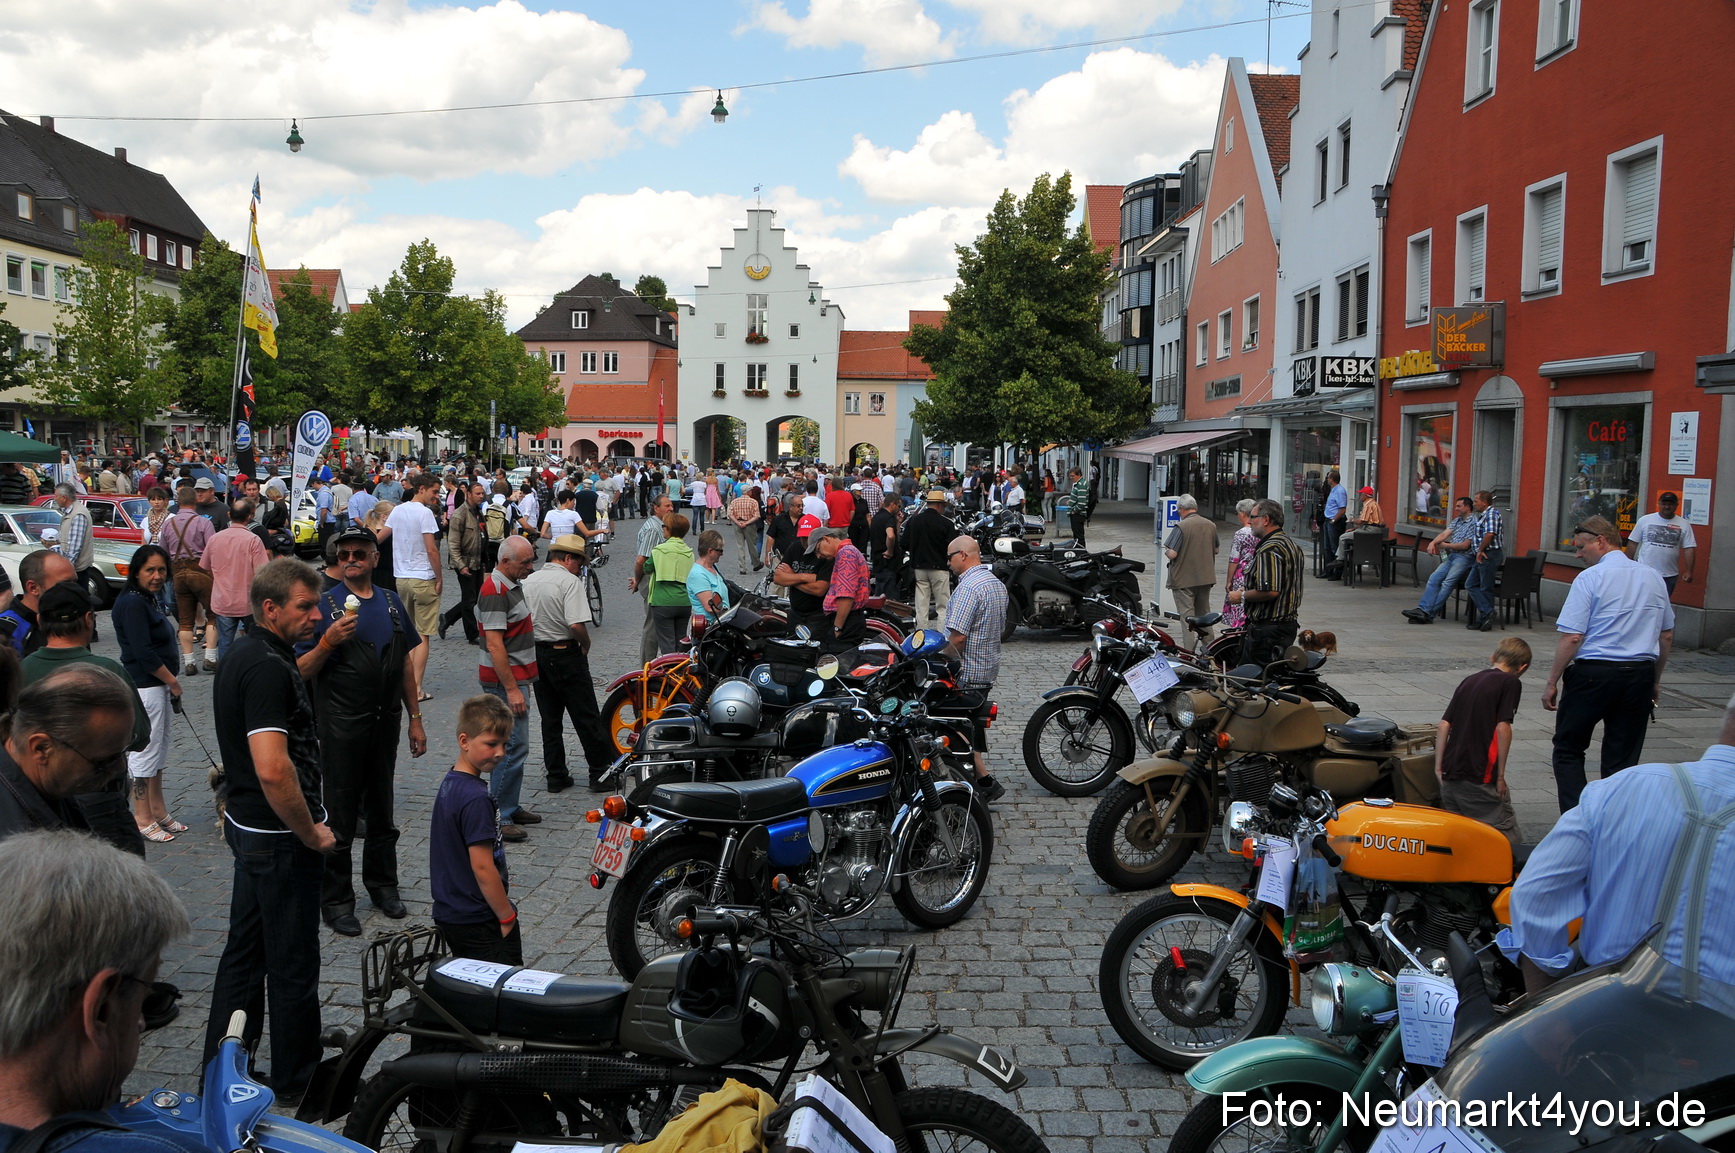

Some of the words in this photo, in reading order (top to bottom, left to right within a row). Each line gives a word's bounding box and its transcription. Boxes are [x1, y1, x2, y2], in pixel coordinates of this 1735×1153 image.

[1446, 333, 1467, 343] DER
[1446, 342, 1486, 352] BÄCKER
[1295, 359, 1312, 381] KBK
[1325, 358, 1375, 375] KBK
[598, 429, 644, 439] Sparkasse
[1587, 420, 1627, 442] Café
[1147, 660, 1166, 675] 446
[858, 769, 891, 780] HONDA
[604, 821, 628, 848] LAU
[1363, 832, 1425, 856] DUCATI
[593, 842, 623, 872] 0759
[1423, 990, 1457, 1017] 376
